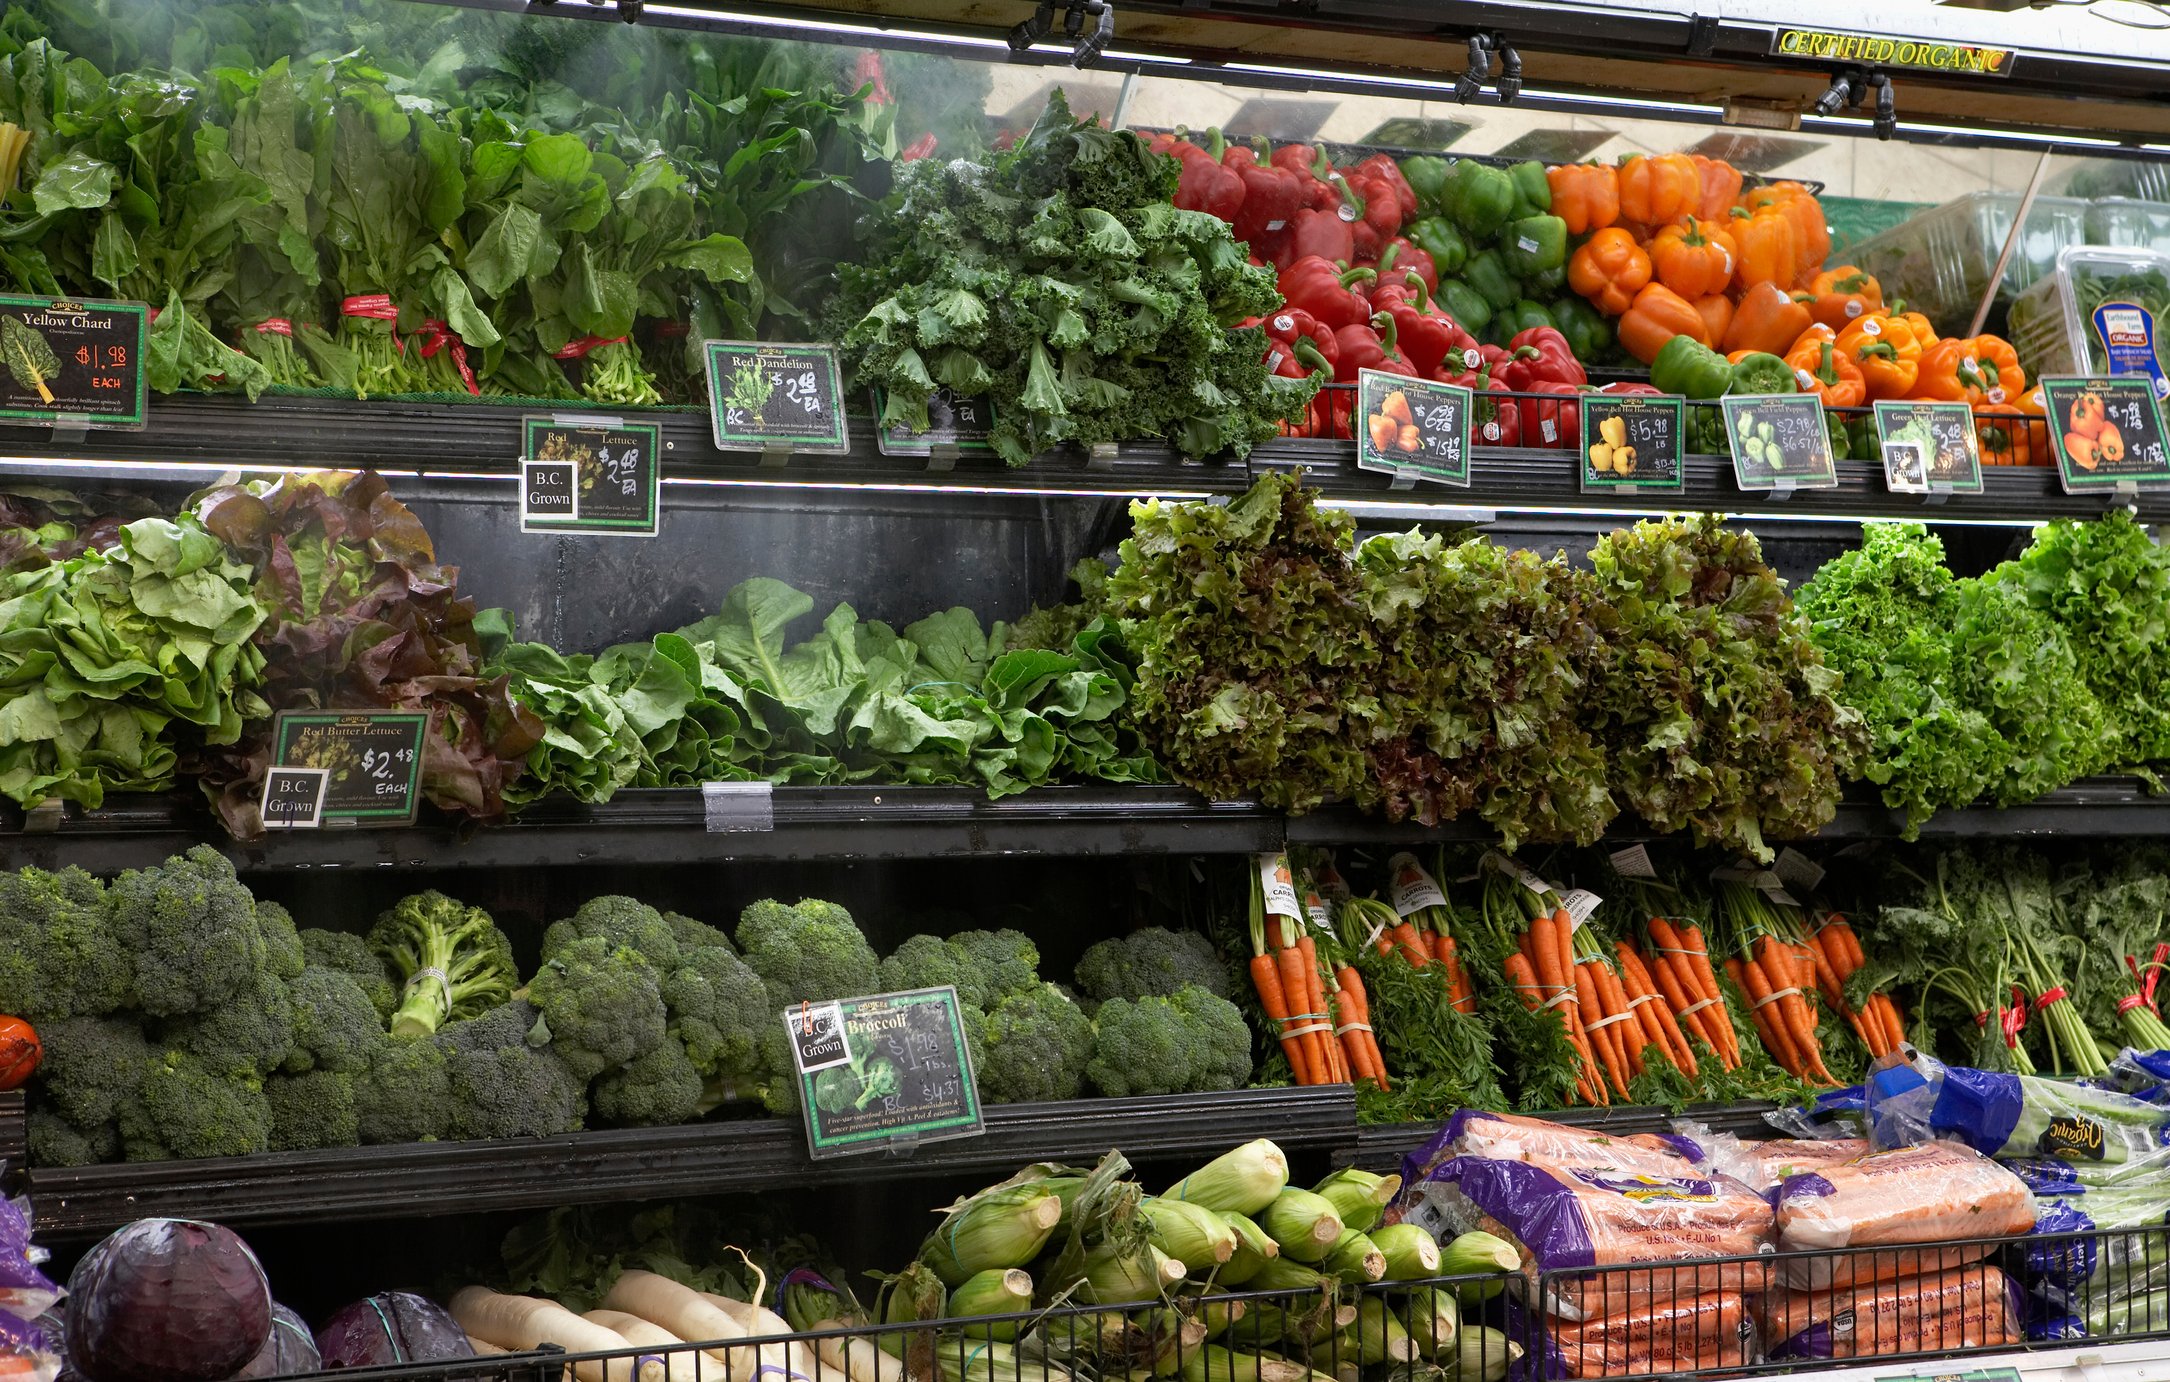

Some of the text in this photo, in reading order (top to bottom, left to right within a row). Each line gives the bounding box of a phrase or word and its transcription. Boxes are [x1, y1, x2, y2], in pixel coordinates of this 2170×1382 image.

[1780, 31, 2004, 73] CERTIFIED ORGANIC
[52, 303, 84, 311] CHOICES
[23, 313, 111, 329] Yellow Chard
[2112, 334, 2144, 343] ORGANIC
[732, 356, 813, 369] Red Dandelion
[92, 378, 121, 389] EACH
[1436, 395, 1461, 405] Peppers
[2054, 392, 2077, 400] Orange
[2124, 392, 2146, 400] Peppers
[805, 397, 820, 412] EA
[1892, 413, 1912, 421] Green
[1931, 413, 1956, 422] Lettuce
[548, 432, 638, 445] Red Lettuce
[1891, 466, 1920, 478] Grown
[536, 472, 563, 485] B.C.
[622, 479, 637, 496] EA
[529, 492, 570, 505] Grown
[303, 727, 402, 736] Red Butter Lettuce
[280, 781, 309, 793] B.C.
[376, 783, 408, 794] EACH
[1402, 885, 1432, 900] CARROTS
[858, 1001, 887, 1011] CHOICES
[848, 1013, 907, 1034] Broccoli
[803, 1040, 841, 1058] Grown
[883, 1094, 907, 1111] BC
[830, 1126, 848, 1134] cancer
[2050, 1114, 2102, 1149] Organic
[1618, 1223, 1650, 1233] Produce
[1646, 1235, 1662, 1245] U.S.
[1705, 1233, 1715, 1242] No
[1838, 1318, 1852, 1326] USDA
[1653, 1348, 1665, 1358] 80
[1678, 1344, 1683, 1353] 5
[1685, 1342, 1692, 1352] lb
